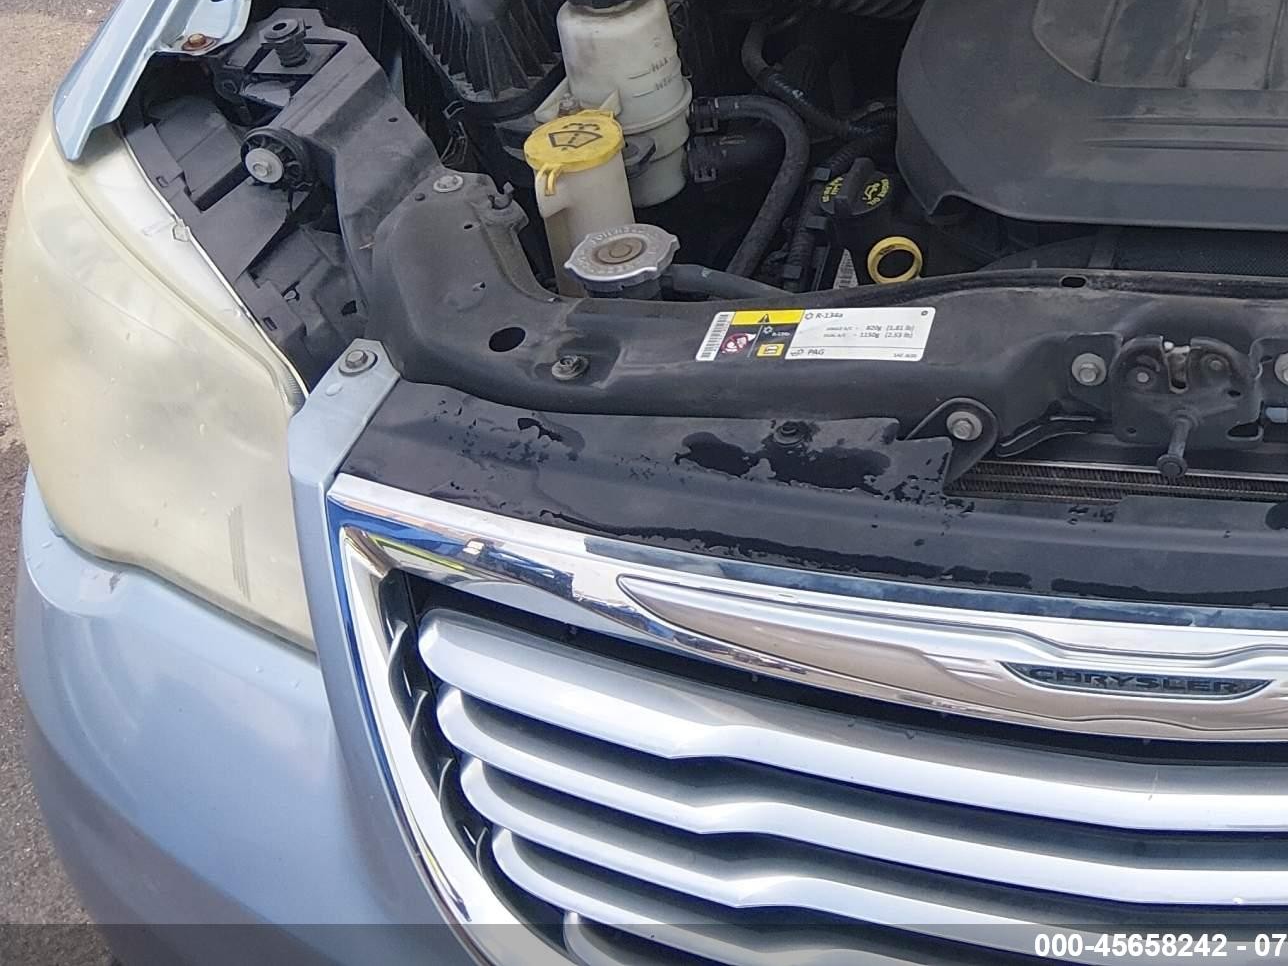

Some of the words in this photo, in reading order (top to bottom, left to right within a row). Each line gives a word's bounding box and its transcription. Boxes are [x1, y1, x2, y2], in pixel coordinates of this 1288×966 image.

[814, 311, 844, 320] R-134a
[807, 348, 825, 356] PAG
[1029, 667, 1236, 693] CHRYSLER
